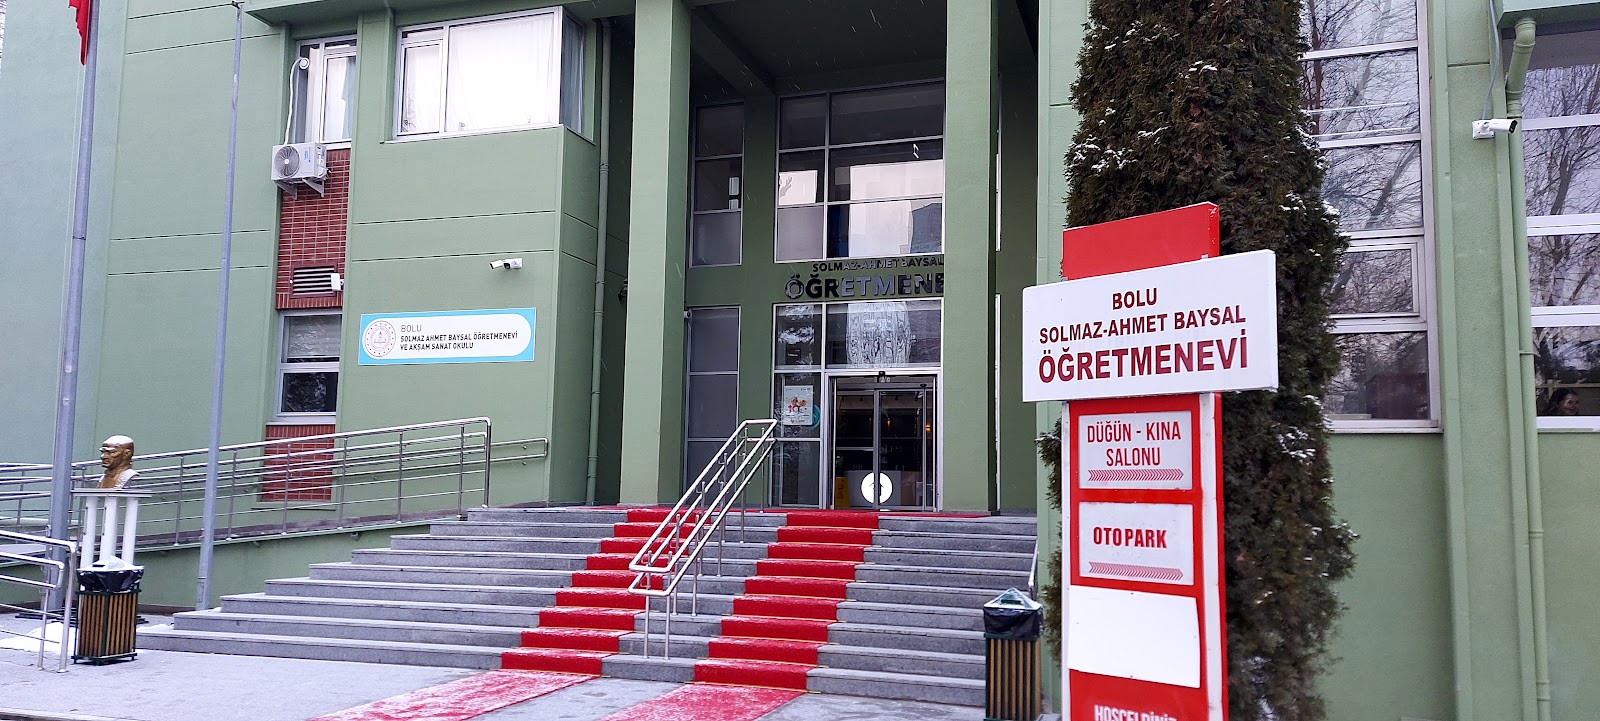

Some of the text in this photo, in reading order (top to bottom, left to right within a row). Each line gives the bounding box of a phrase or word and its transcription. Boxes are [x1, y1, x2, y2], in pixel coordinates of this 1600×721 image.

[812, 256, 944, 272] SOLMAZ-AHMET BAYSAL
[784, 273, 944, 299] ÖĞRETMENE
[1112, 287, 1157, 310] BOLU
[401, 325, 422, 333] BOLU
[1039, 305, 1246, 344] SOLMAZ-AHMET BAYSAL
[400, 335, 425, 343] SOLMAZ
[425, 334, 447, 342] AHMET
[473, 332, 518, 340] ÖĞRETMENEVİ
[409, 343, 430, 352] AKŞAM
[1039, 328, 1248, 383] ÖĞRETMENEVİ
[1087, 420, 1132, 443] DÜĞÜN
[1146, 421, 1182, 441] KINA
[1106, 447, 1161, 467] SALONU
[1093, 526, 1168, 549] OTOPARK
